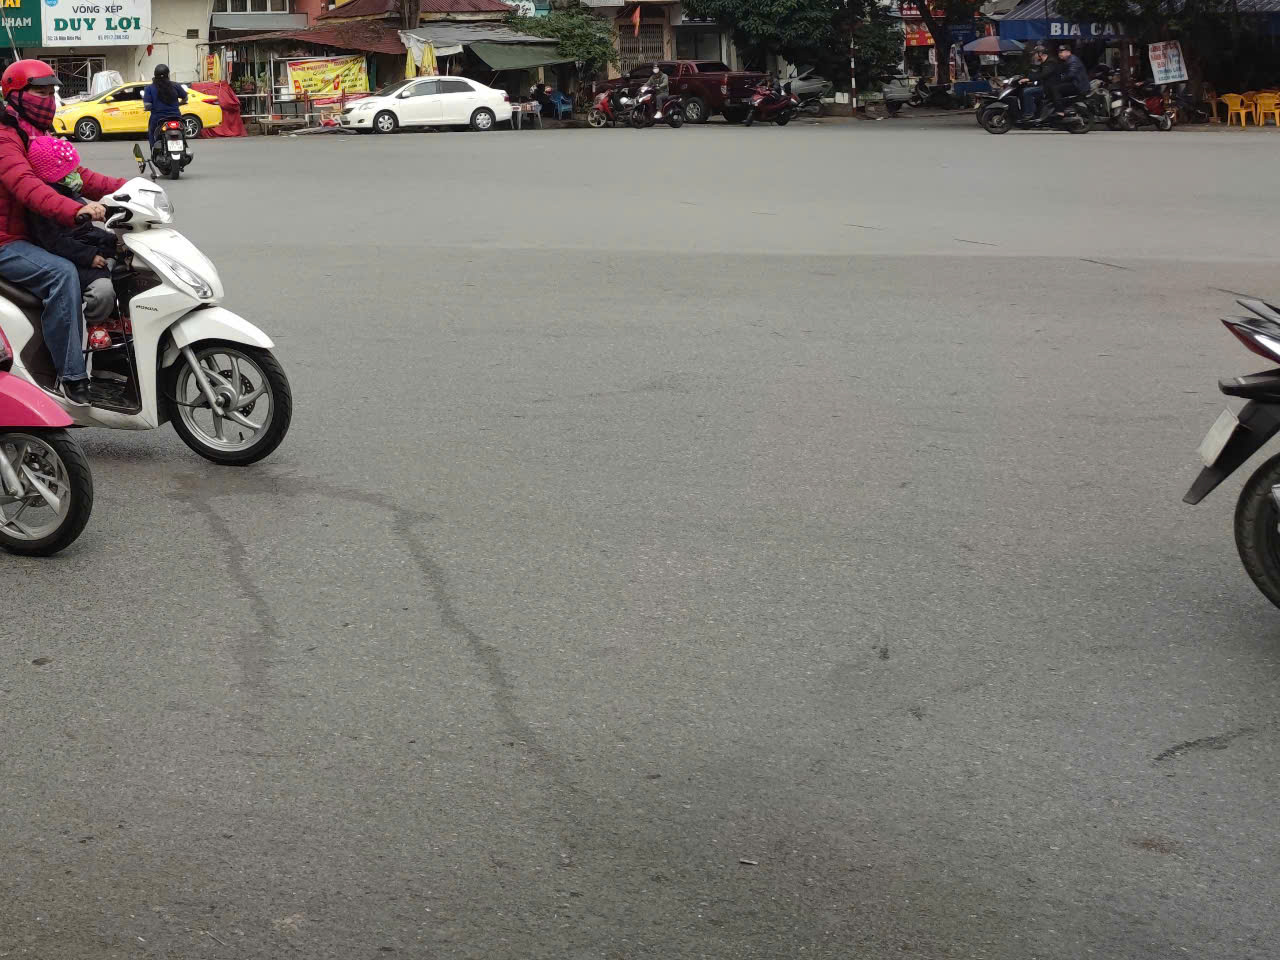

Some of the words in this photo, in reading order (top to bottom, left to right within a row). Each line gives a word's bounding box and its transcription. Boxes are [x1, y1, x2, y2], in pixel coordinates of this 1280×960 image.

[72, 3, 100, 14] VÕNG
[53, 17, 96, 31] DUY
[105, 16, 141, 33] LỢI
[1050, 22, 1081, 36] BIA
[136, 304, 159, 312] HONDA
